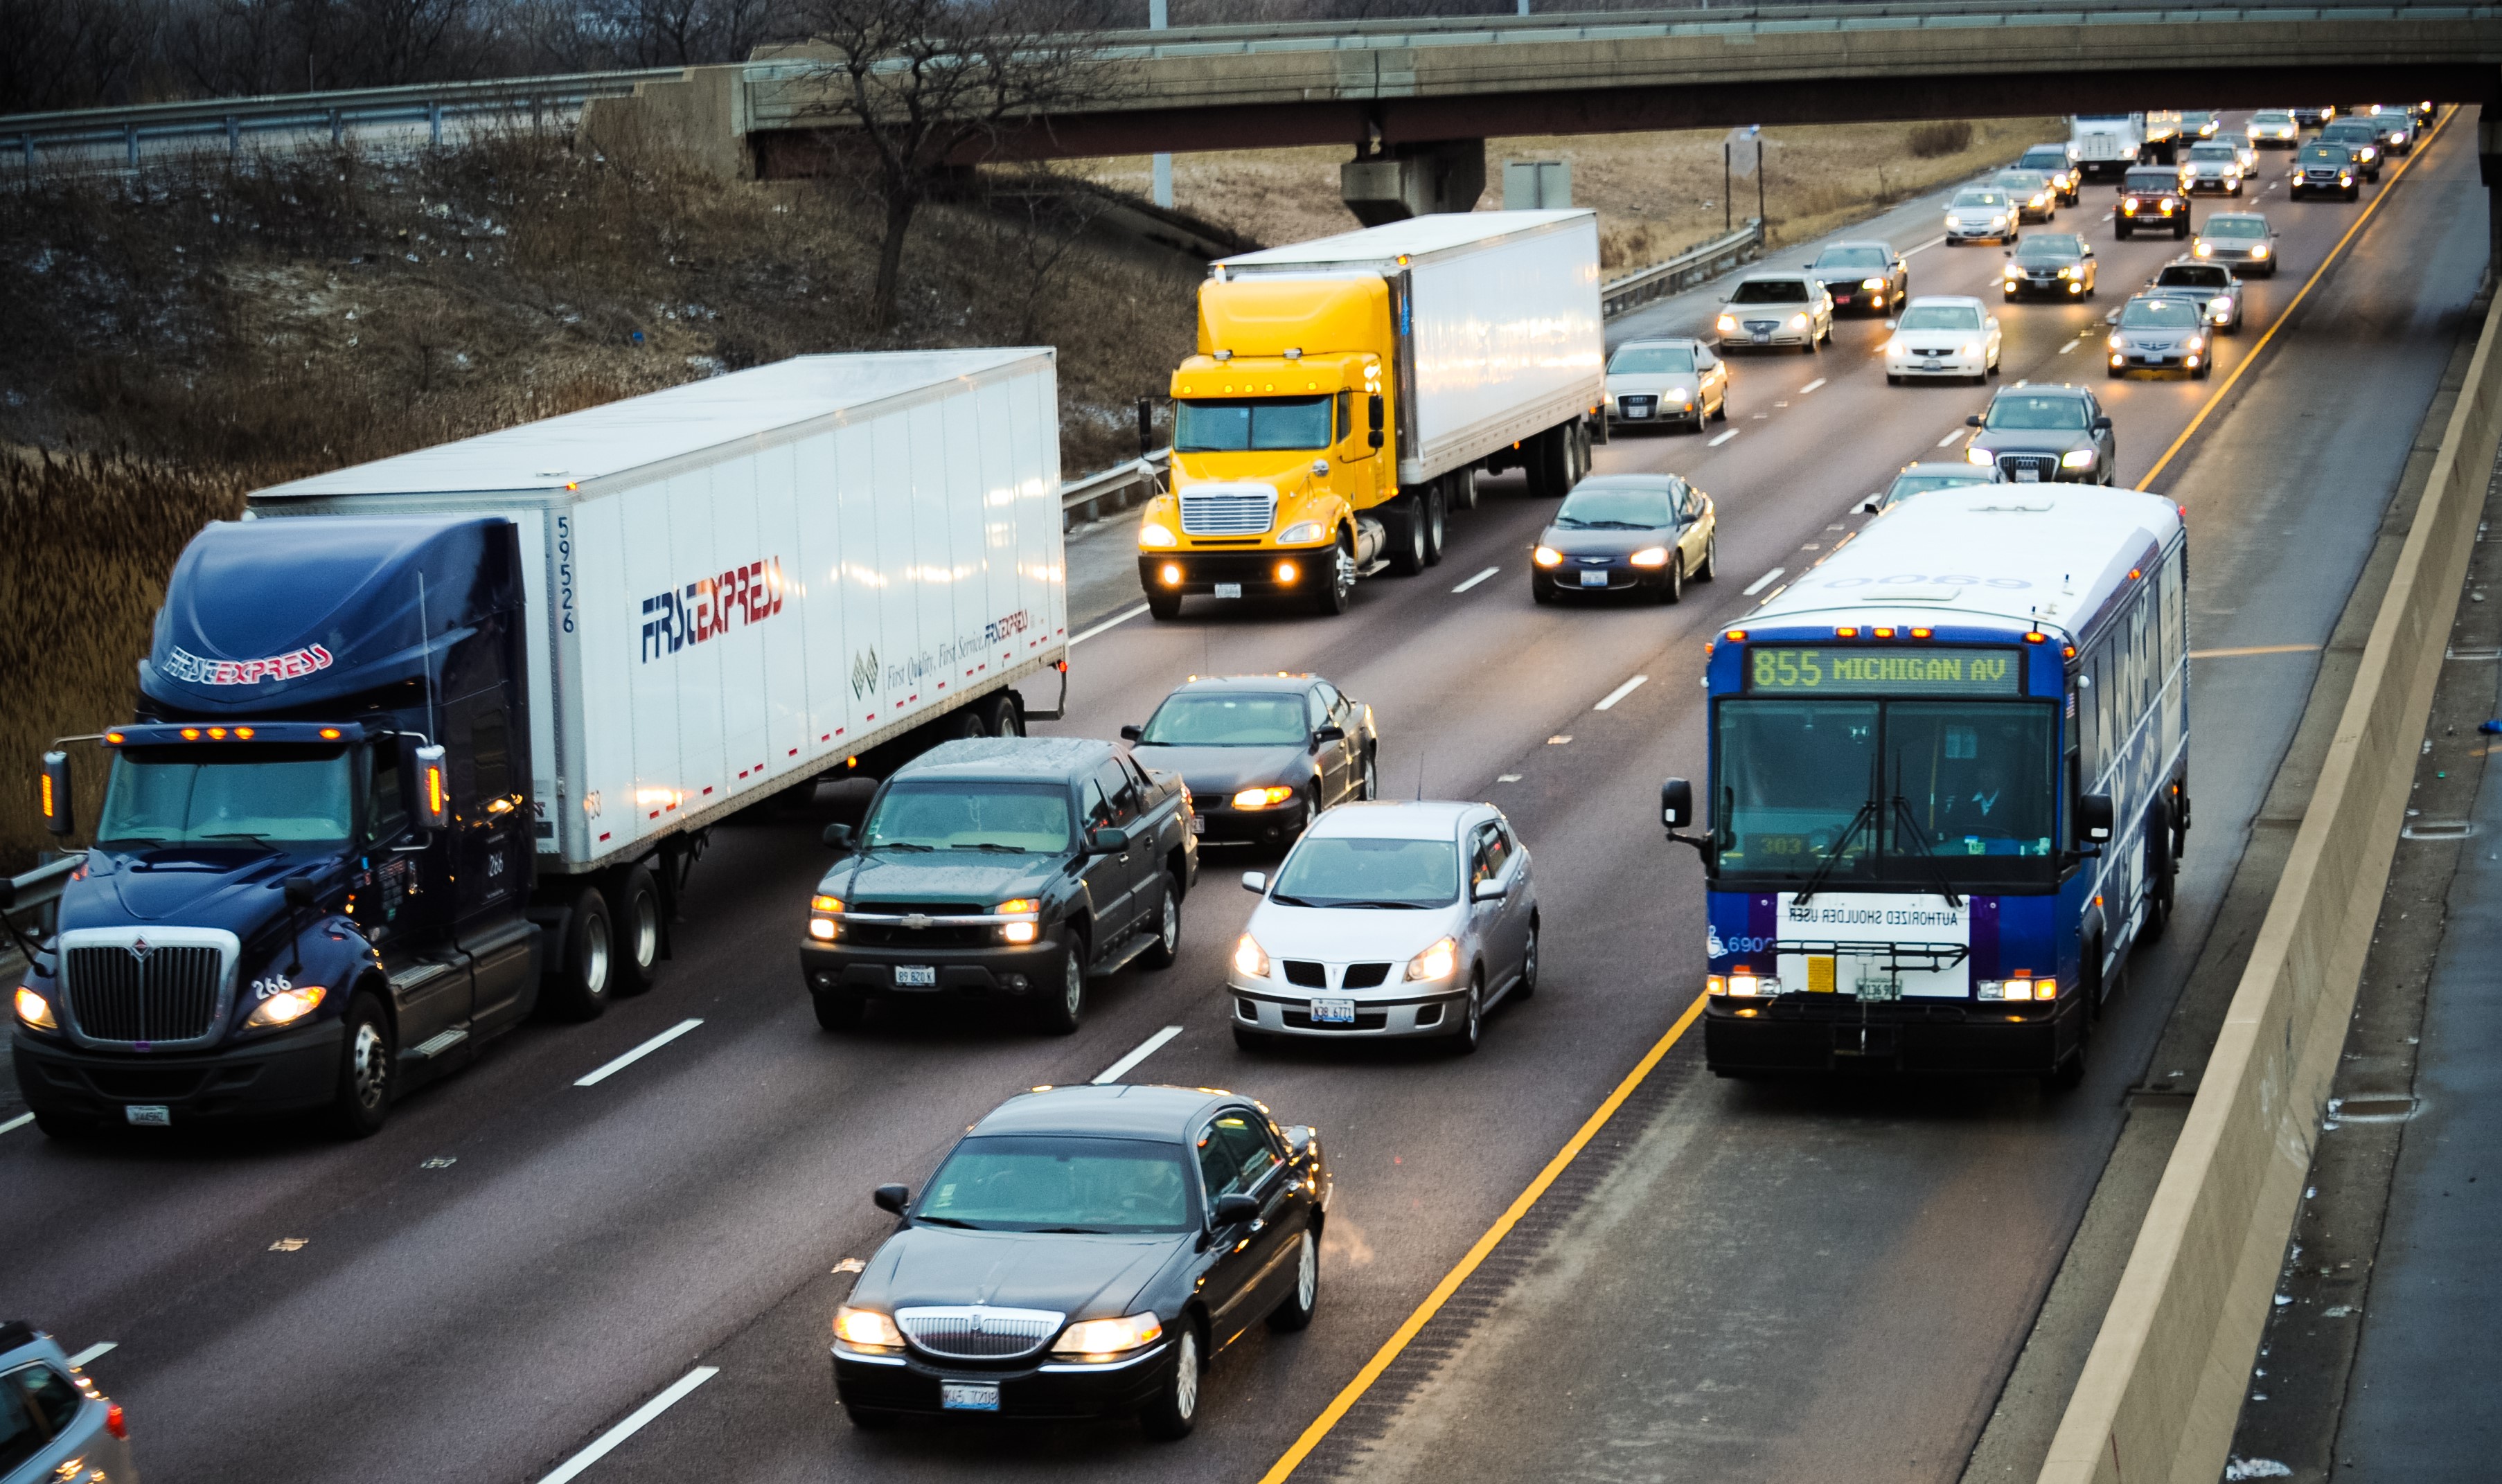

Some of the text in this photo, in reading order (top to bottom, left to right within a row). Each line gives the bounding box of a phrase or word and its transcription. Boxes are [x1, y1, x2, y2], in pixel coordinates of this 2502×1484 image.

[557, 516, 575, 634] 59526
[887, 665, 905, 690] First
[939, 643, 956, 668] First
[1753, 650, 2006, 687] 855 MICHIGAN AV
[487, 850, 504, 877] 266
[251, 973, 292, 1000] 266
